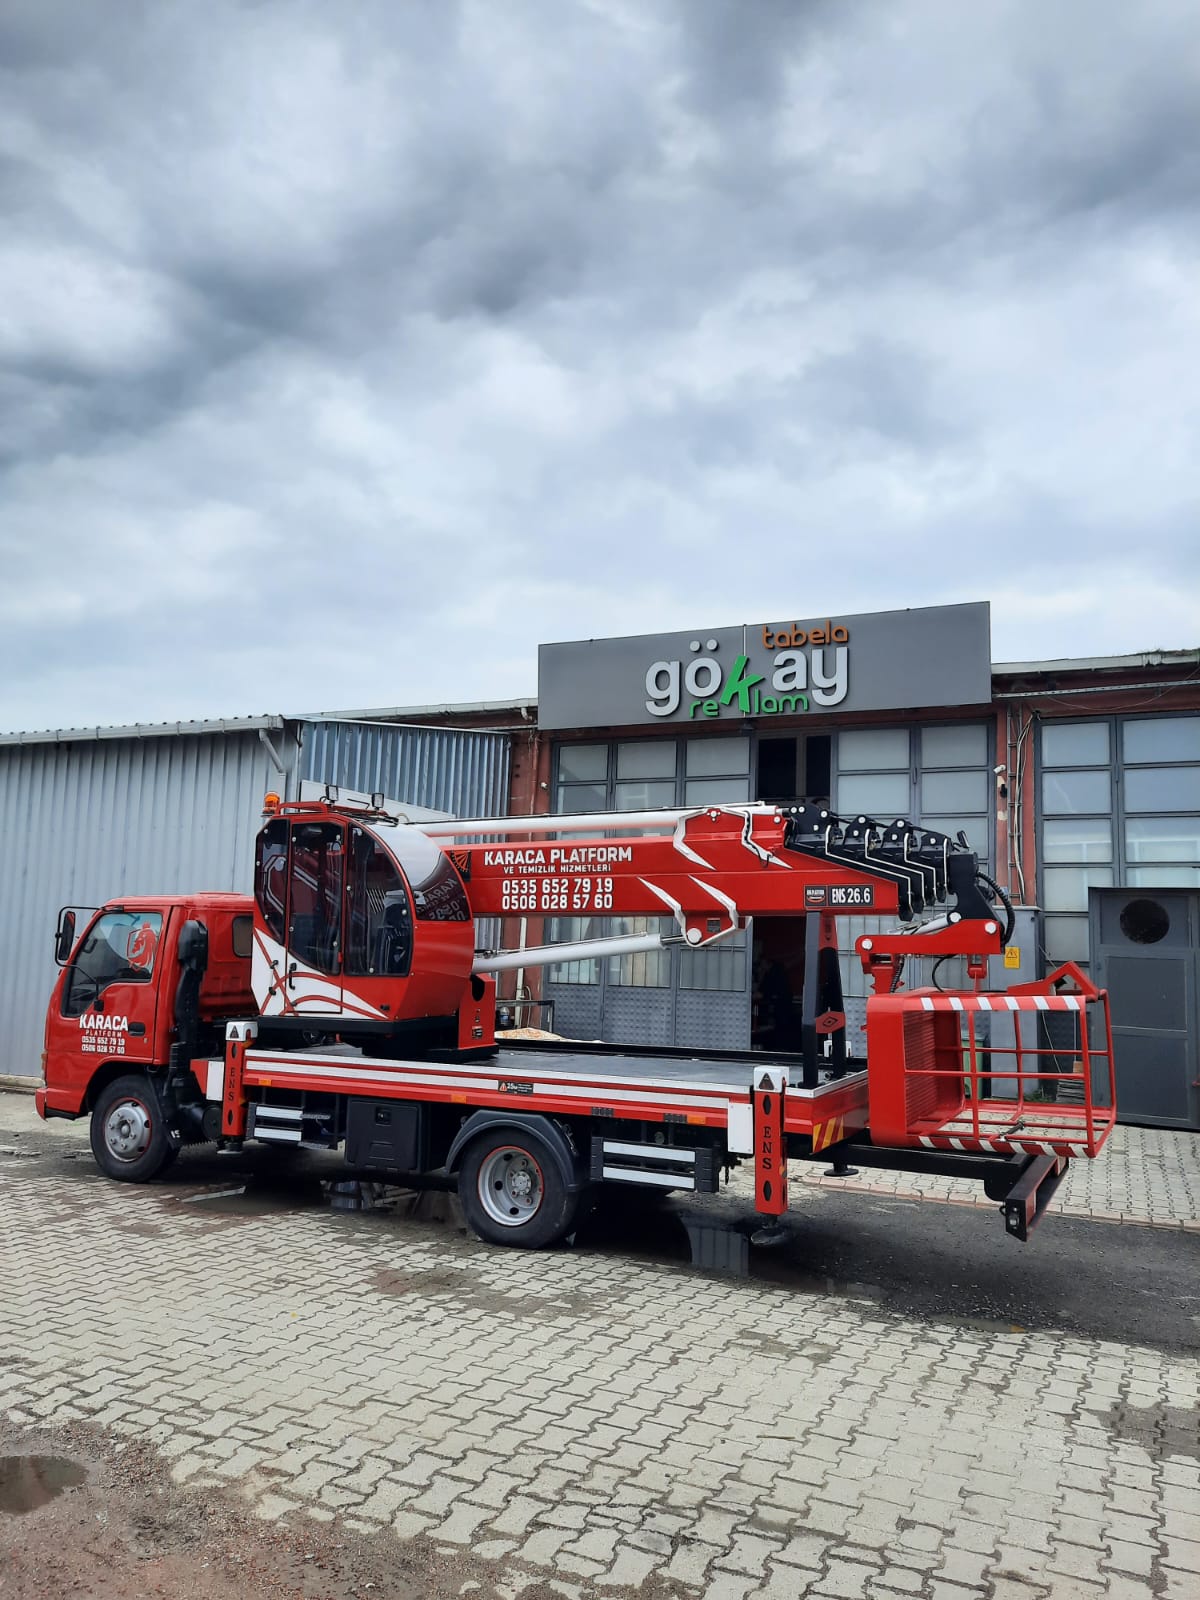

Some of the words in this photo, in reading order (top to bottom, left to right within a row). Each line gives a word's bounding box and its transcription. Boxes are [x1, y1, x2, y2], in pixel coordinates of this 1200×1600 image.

[761, 620, 849, 649] tabela
[484, 849, 546, 866] KARACA
[550, 846, 632, 864] PLATFORM
[503, 866, 514, 874] VE
[502, 879, 537, 894] 0535
[541, 878, 569, 893] 652
[573, 878, 591, 893] 79
[596, 877, 613, 893] 19
[501, 895, 537, 910] 0506
[541, 894, 568, 910] 028
[572, 894, 590, 909] 57
[594, 893, 613, 909] 60
[831, 887, 846, 903] ENS
[847, 887, 871, 903] 26.6
[79, 1014, 128, 1031] KARACA
[81, 1036, 96, 1044] 0535
[109, 1037, 117, 1045] 79
[117, 1038, 126, 1046] 19
[85, 1029, 122, 1038] PLATFORM
[108, 1045, 116, 1053] 57
[117, 1046, 125, 1054] 60
[228, 1067, 236, 1101] ENS
[762, 1126, 773, 1170] ENS
